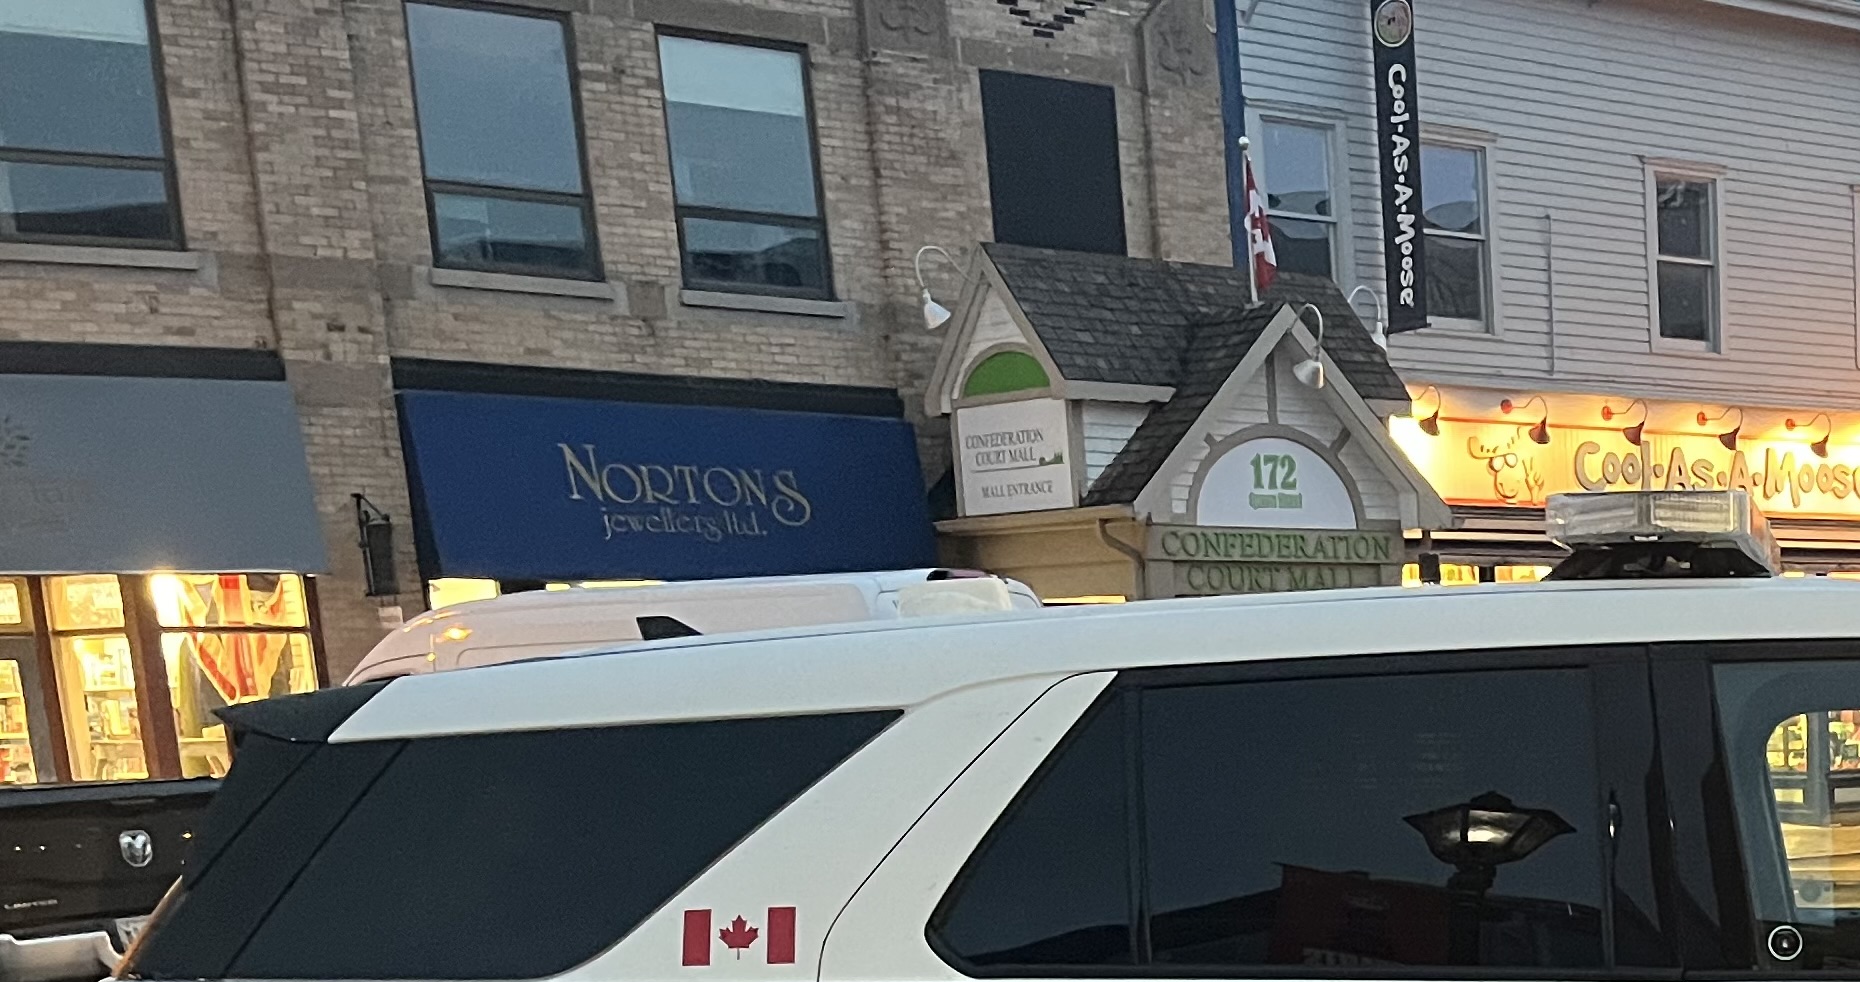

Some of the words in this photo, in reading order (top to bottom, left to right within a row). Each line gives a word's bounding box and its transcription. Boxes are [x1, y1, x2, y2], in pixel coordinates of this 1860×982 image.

[965, 428, 1044, 450] CONFEDERATION
[975, 450, 1006, 467] COURT
[1008, 447, 1037, 464] MALL
[557, 443, 811, 527] NORTONS
[1250, 453, 1297, 491] 172
[981, 483, 1005, 499] MALL
[1006, 480, 1053, 498] ENTRANCE
[600, 506, 722, 542] jewellers
[723, 510, 768, 536] ltd.
[1161, 530, 1391, 561] CONFEDERATION
[1187, 564, 1281, 592] COURT
